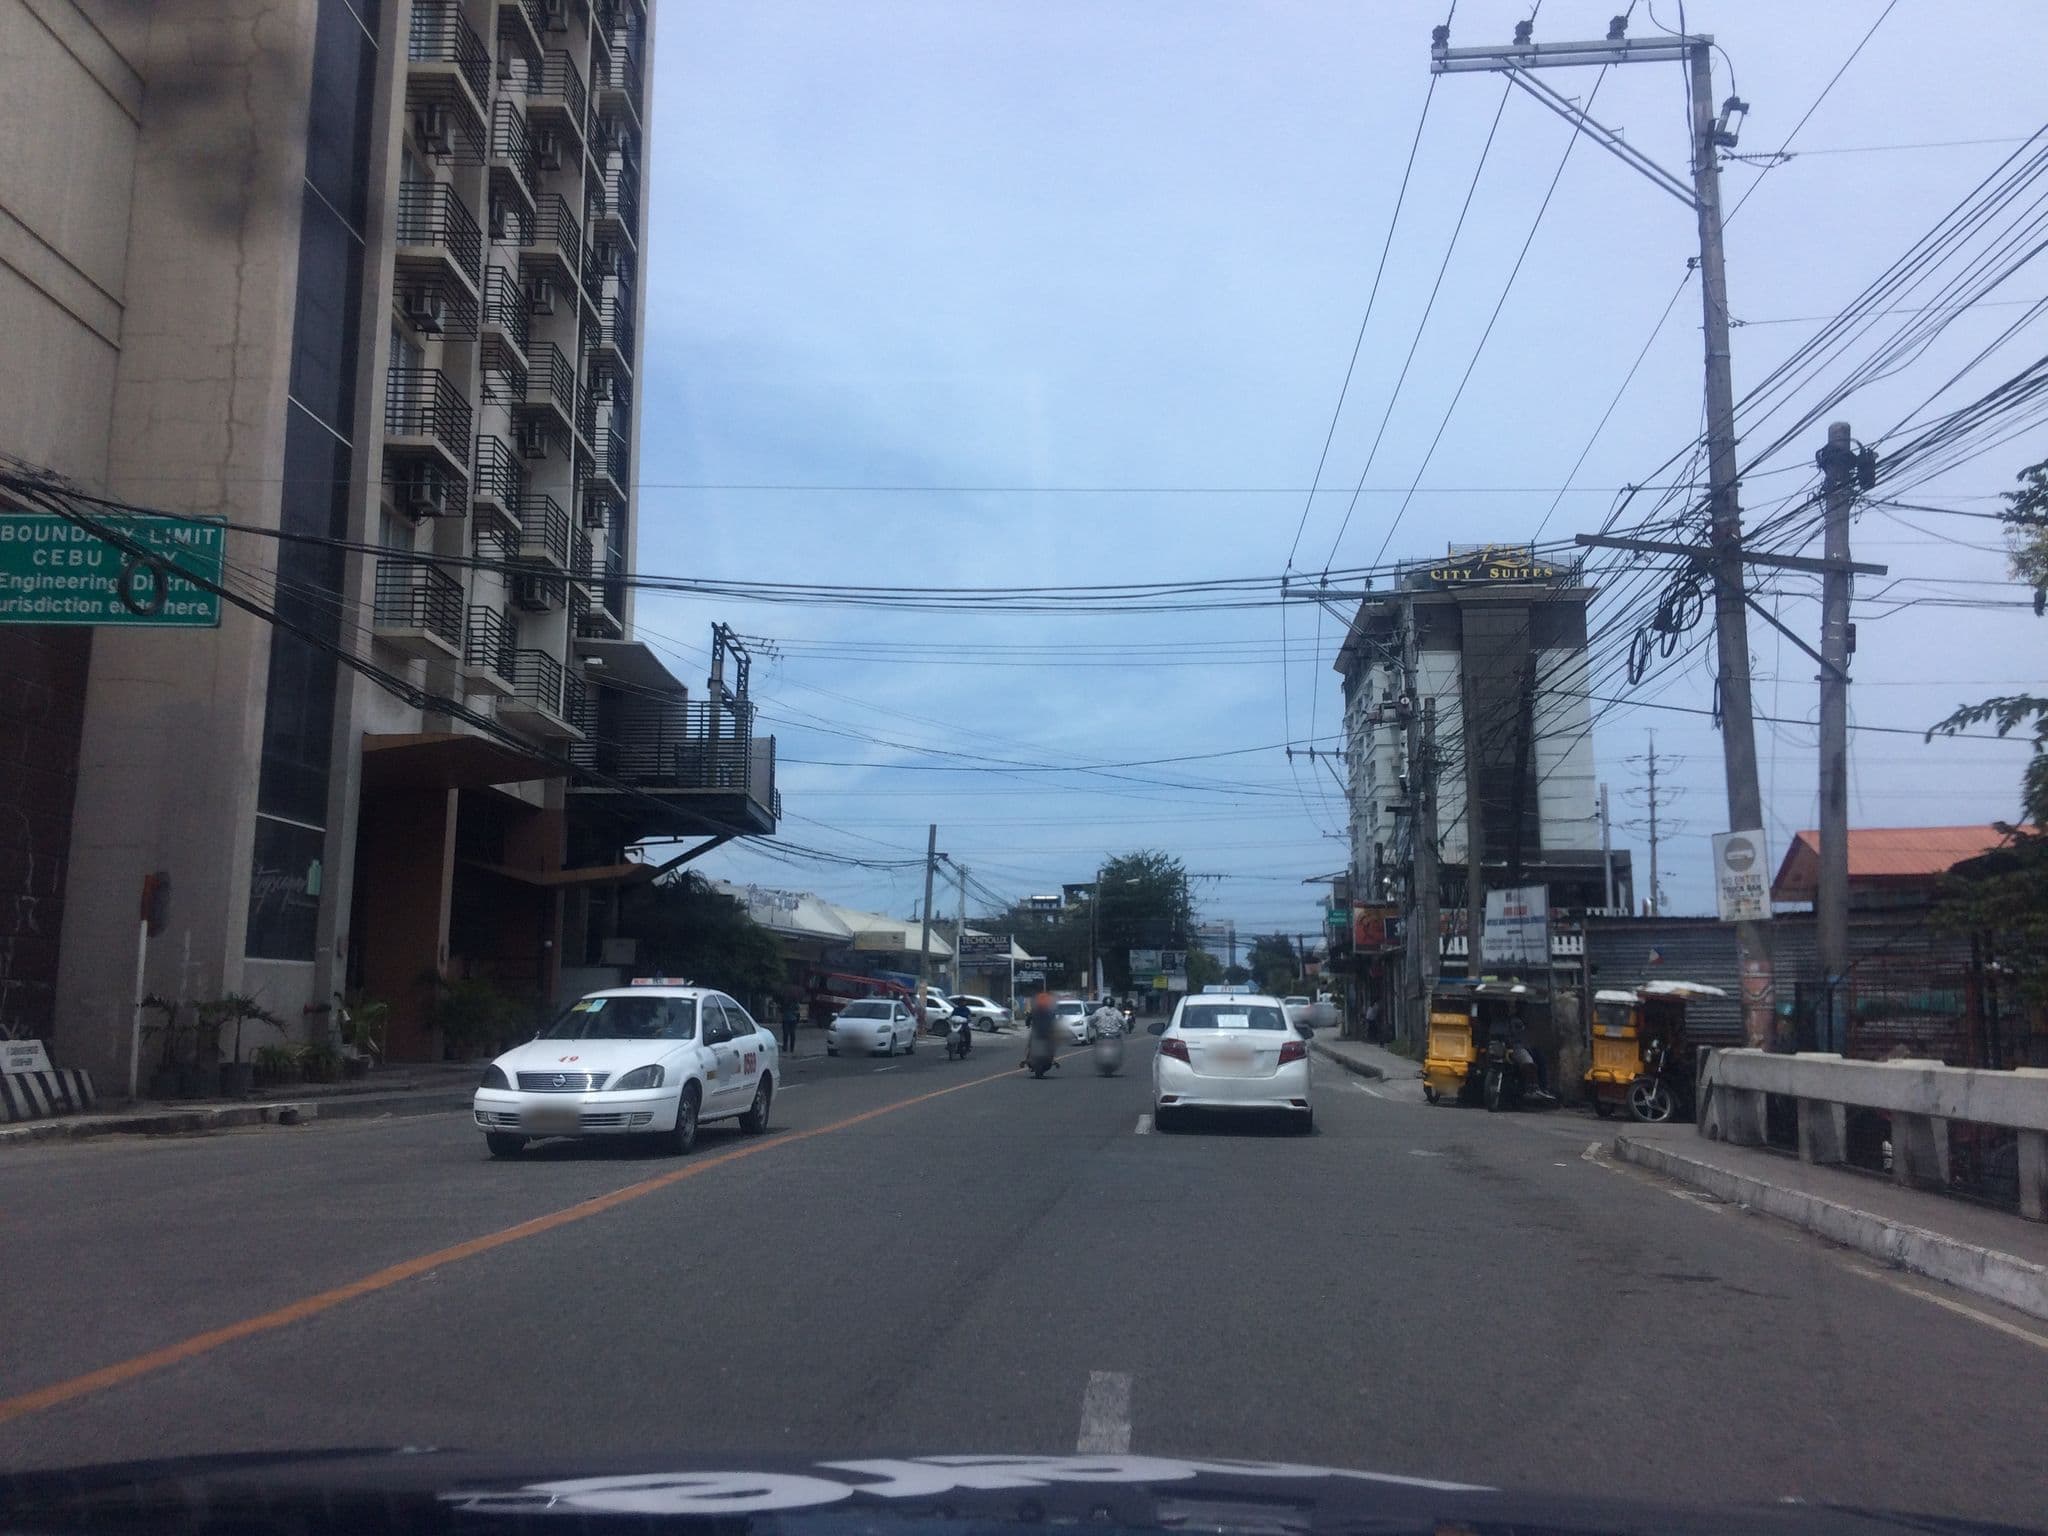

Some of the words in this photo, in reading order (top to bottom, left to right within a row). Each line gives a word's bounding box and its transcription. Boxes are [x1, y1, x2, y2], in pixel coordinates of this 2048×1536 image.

[150, 528, 216, 544] LIMIT
[33, 549, 102, 566] CEBU
[0, 572, 118, 592] Engineering
[1431, 569, 1472, 580] CITY
[1489, 568, 1553, 579] SUITES
[0, 596, 102, 613] urisdiction
